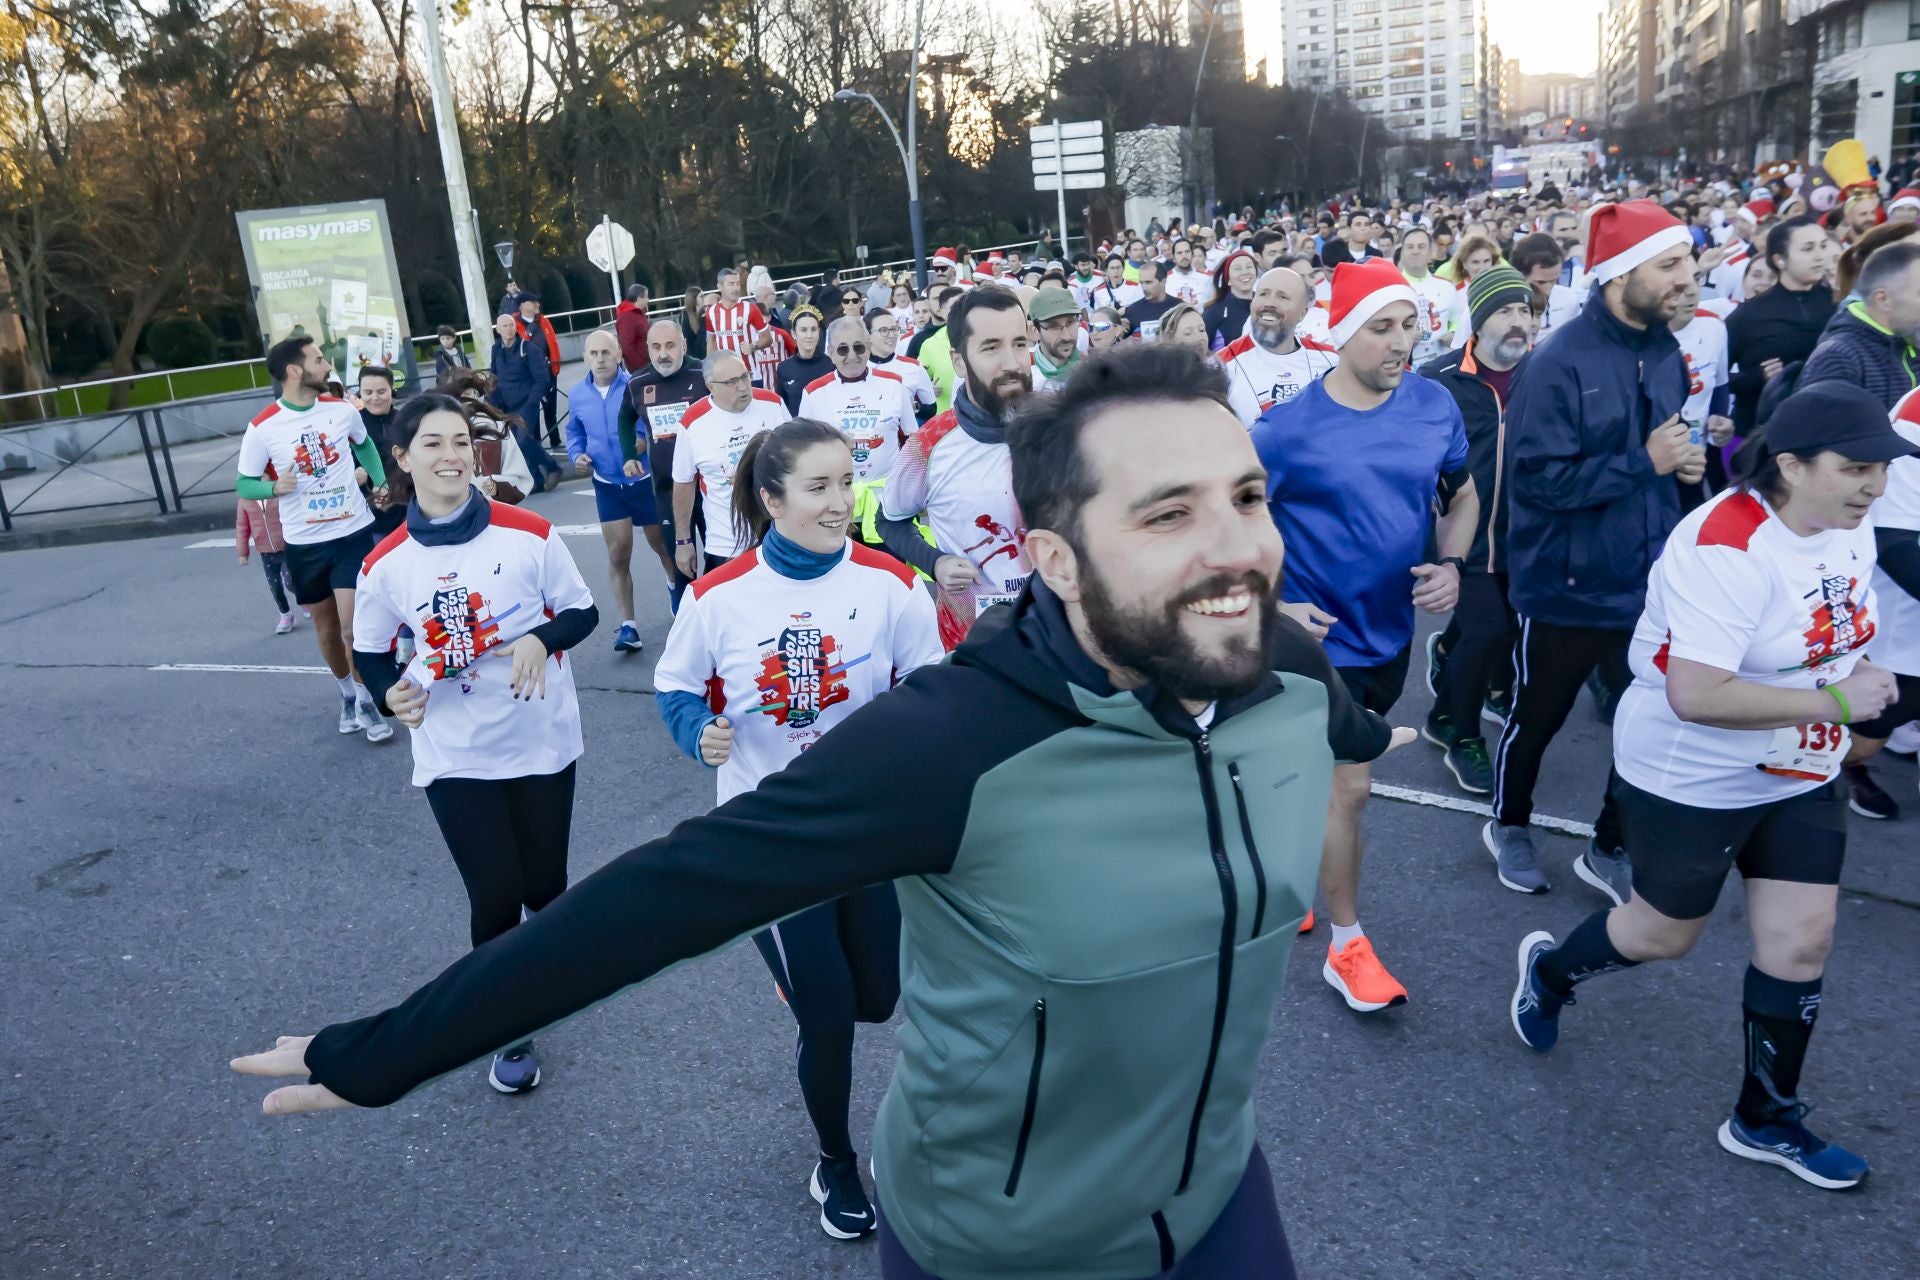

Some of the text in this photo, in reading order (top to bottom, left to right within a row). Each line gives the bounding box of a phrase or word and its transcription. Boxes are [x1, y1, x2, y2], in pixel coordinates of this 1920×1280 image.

[262, 269, 309, 281] DESCARGA
[264, 277, 324, 291] NUESTRA APP
[841, 417, 878, 430] 3707
[308, 494, 345, 511] 4937
[448, 588, 468, 606] 55
[439, 603, 468, 620] SAN
[798, 630, 820, 646] 55
[786, 640, 819, 659] SAN
[787, 658, 819, 677] SIL
[788, 676, 820, 694] VES
[787, 693, 820, 712] TRE
